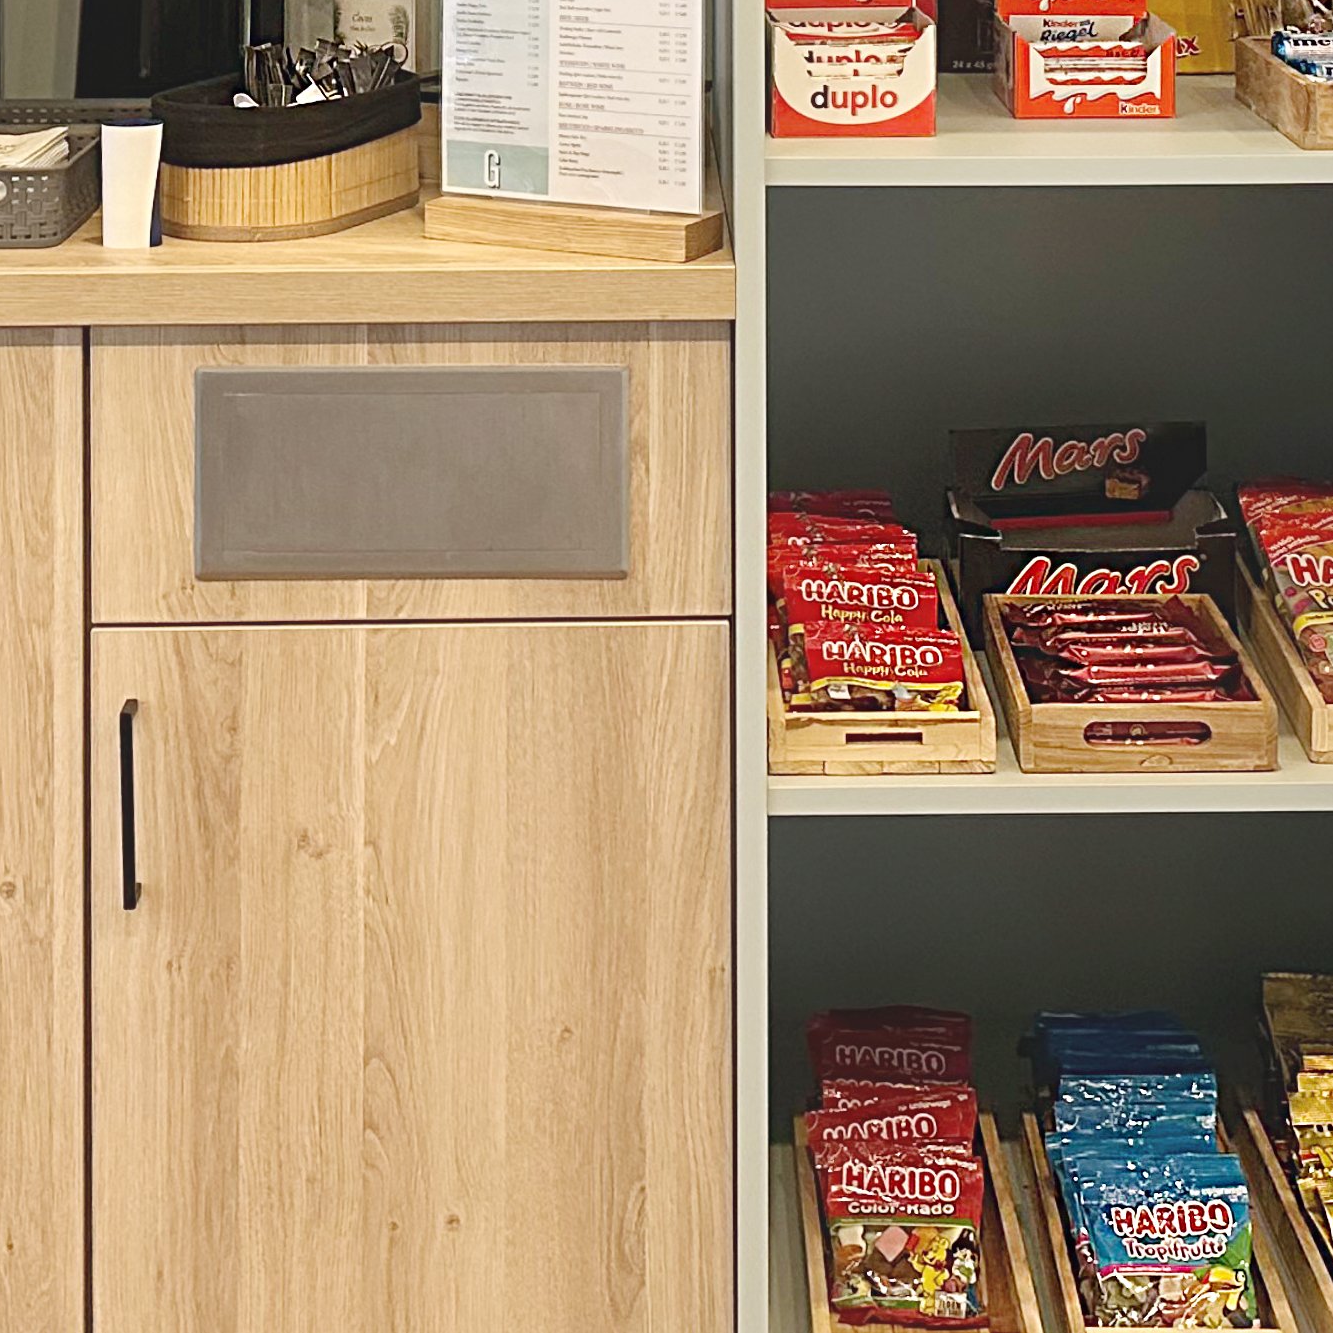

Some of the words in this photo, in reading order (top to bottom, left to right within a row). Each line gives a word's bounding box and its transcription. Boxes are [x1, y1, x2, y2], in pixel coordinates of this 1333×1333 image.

[811, 85, 898, 117] duplo
[483, 149, 501, 189] G
[992, 429, 1146, 491] Mars
[1006, 555, 1200, 594] Mars
[801, 579, 919, 610] HARIBO
[821, 604, 867, 624] Happy
[870, 609, 904, 624] Cola
[822, 640, 944, 667] HARIBO
[844, 662, 890, 678] Happy
[894, 664, 928, 678] Cola
[836, 1044, 946, 1075] HARIBO
[842, 1161, 960, 1202] HARIBO
[1110, 1199, 1234, 1236] HARIBO
[1123, 1235, 1227, 1261] Tropifrutti
